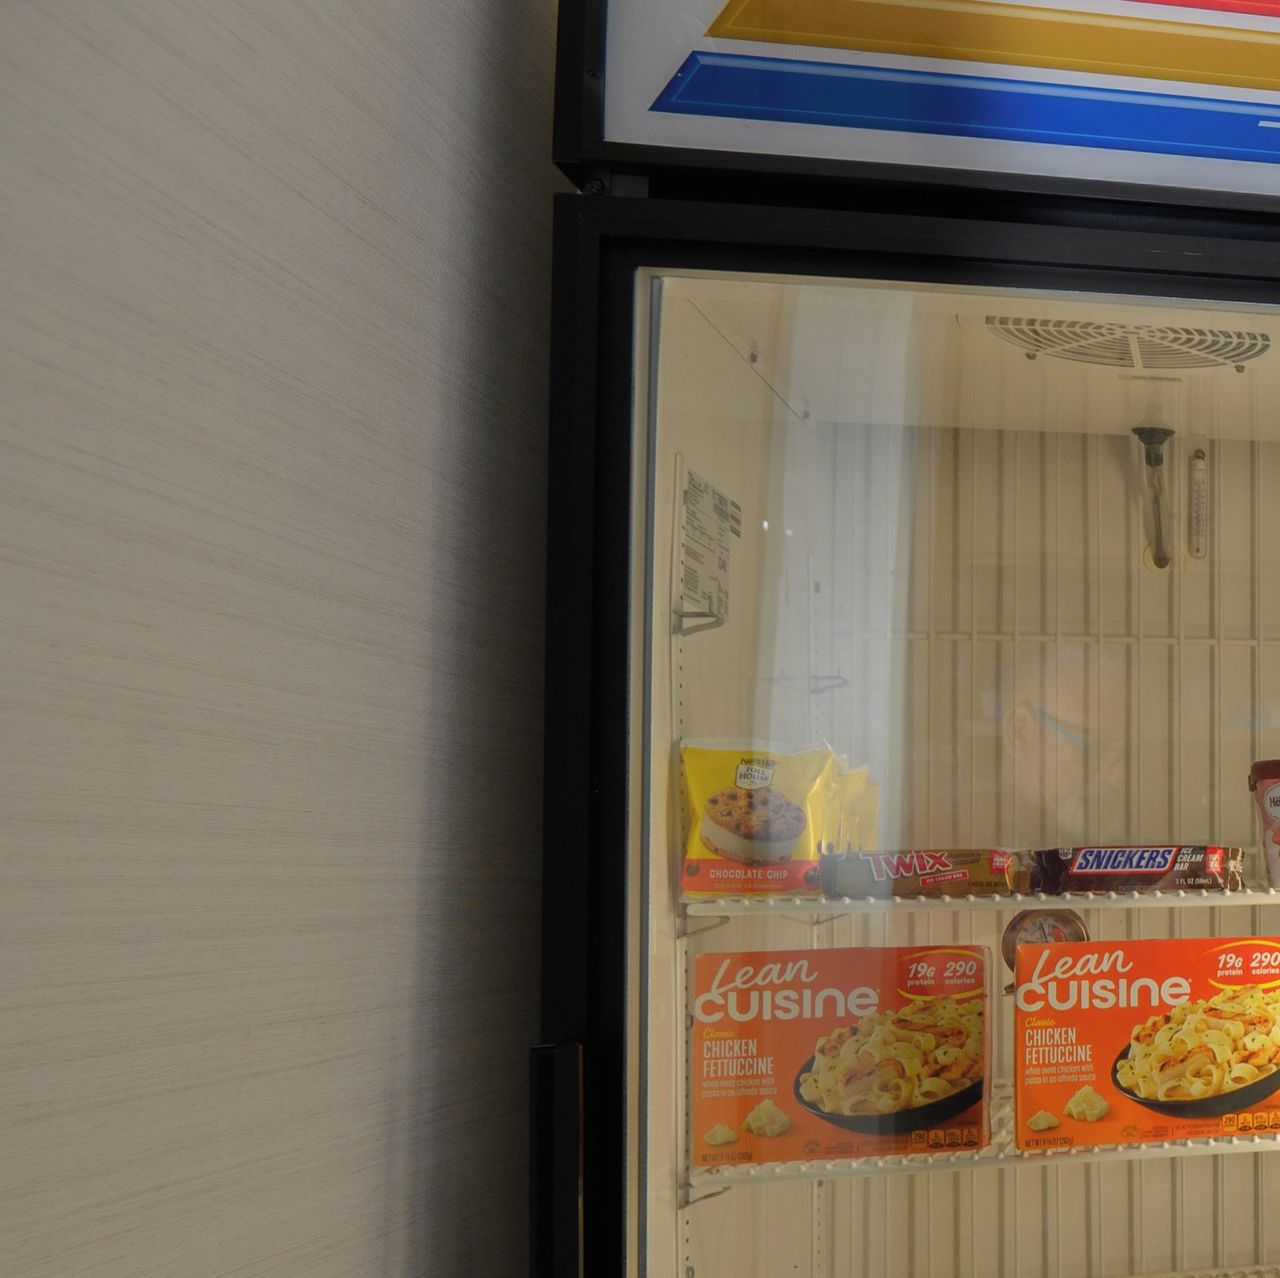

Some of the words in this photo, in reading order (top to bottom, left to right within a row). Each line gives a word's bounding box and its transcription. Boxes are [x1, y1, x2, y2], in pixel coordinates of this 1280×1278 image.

[1075, 849, 1174, 871] SNICKERS
[1174, 862, 1190, 871] BAR
[1177, 854, 1204, 863] CREAM
[708, 868, 763, 879] CHOCOLATE
[766, 868, 789, 879] CHIP
[711, 958, 818, 996] Lean
[943, 960, 977, 977] 290
[1030, 947, 1134, 987] Lean
[1216, 967, 1243, 977] protein
[1251, 966, 1280, 976] calories
[907, 978, 935, 988] protein
[944, 976, 976, 985] calories
[1025, 1026, 1077, 1047] CHICKEN
[703, 1038, 758, 1059] CHICKEN
[1025, 1044, 1093, 1065] FETTUCCINE
[703, 1056, 775, 1078] FETTUCCINE
